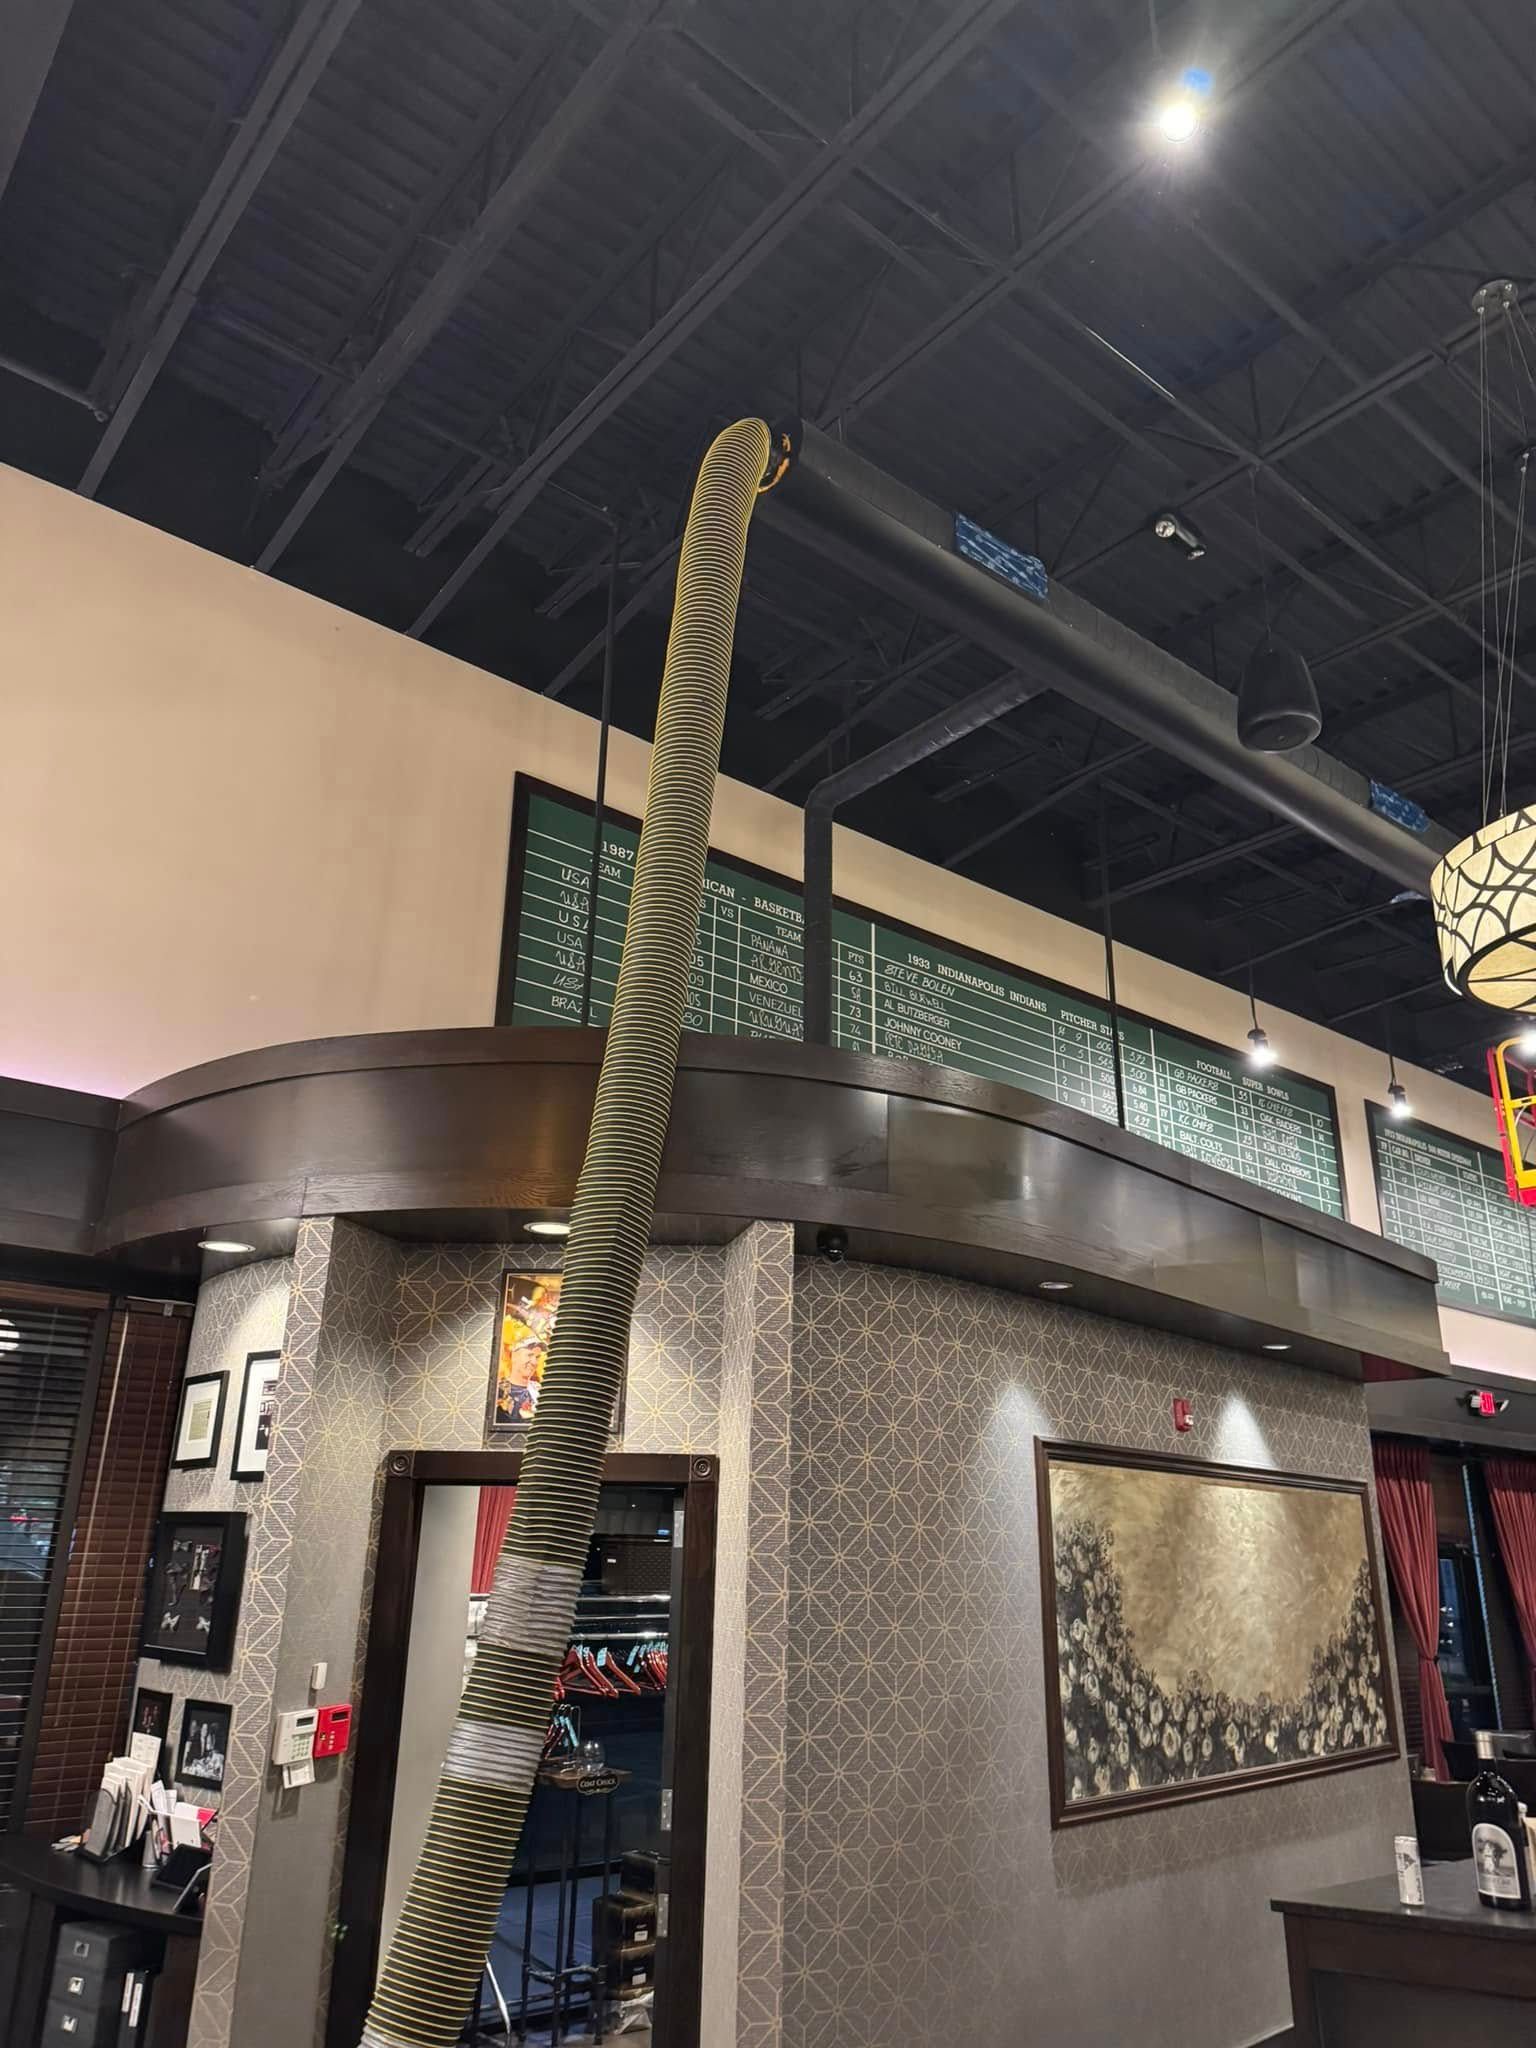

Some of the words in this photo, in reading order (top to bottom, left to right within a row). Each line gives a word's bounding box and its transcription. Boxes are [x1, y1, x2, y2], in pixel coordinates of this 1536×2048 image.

[561, 867, 591, 889] USA
[601, 841, 635, 861] 1987
[754, 896, 805, 925] BASKETB
[598, 861, 622, 879] EAM
[720, 906, 734, 919] VS
[557, 931, 583, 949] USA
[751, 934, 790, 959] PANAMA
[848, 951, 865, 965] PTS
[749, 972, 789, 994] MEXICO
[848, 970, 864, 984] 63
[884, 964, 919, 985] STEVE
[921, 977, 956, 997] BOLEN
[884, 981, 906, 998] BILL
[907, 953, 931, 970] 1933
[937, 964, 1005, 997] INDIANAPOLIS
[1008, 990, 1048, 1012] INDIANS
[1060, 1010, 1098, 1031] PITCHER
[551, 995, 599, 1018] BRAZL
[849, 1005, 862, 1018] 73
[884, 998, 895, 1011] AL
[897, 1002, 950, 1030] BUTZBERGER
[884, 1016, 921, 1038] JOHNNY
[922, 1029, 962, 1051] COONEY
[1061, 1075, 1068, 1086] 2
[1174, 1068, 1185, 1079] GB
[1186, 1069, 1219, 1091] PACKERS
[1196, 1060, 1232, 1080] FOOTBALL
[1242, 1076, 1263, 1092] SUPER
[1266, 1085, 1290, 1101] BOWLS
[1175, 1084, 1187, 1095] GB
[1187, 1087, 1218, 1106] PACKERS
[1199, 1136, 1223, 1152] COLTS
[1281, 1161, 1312, 1180] COWBOYS
